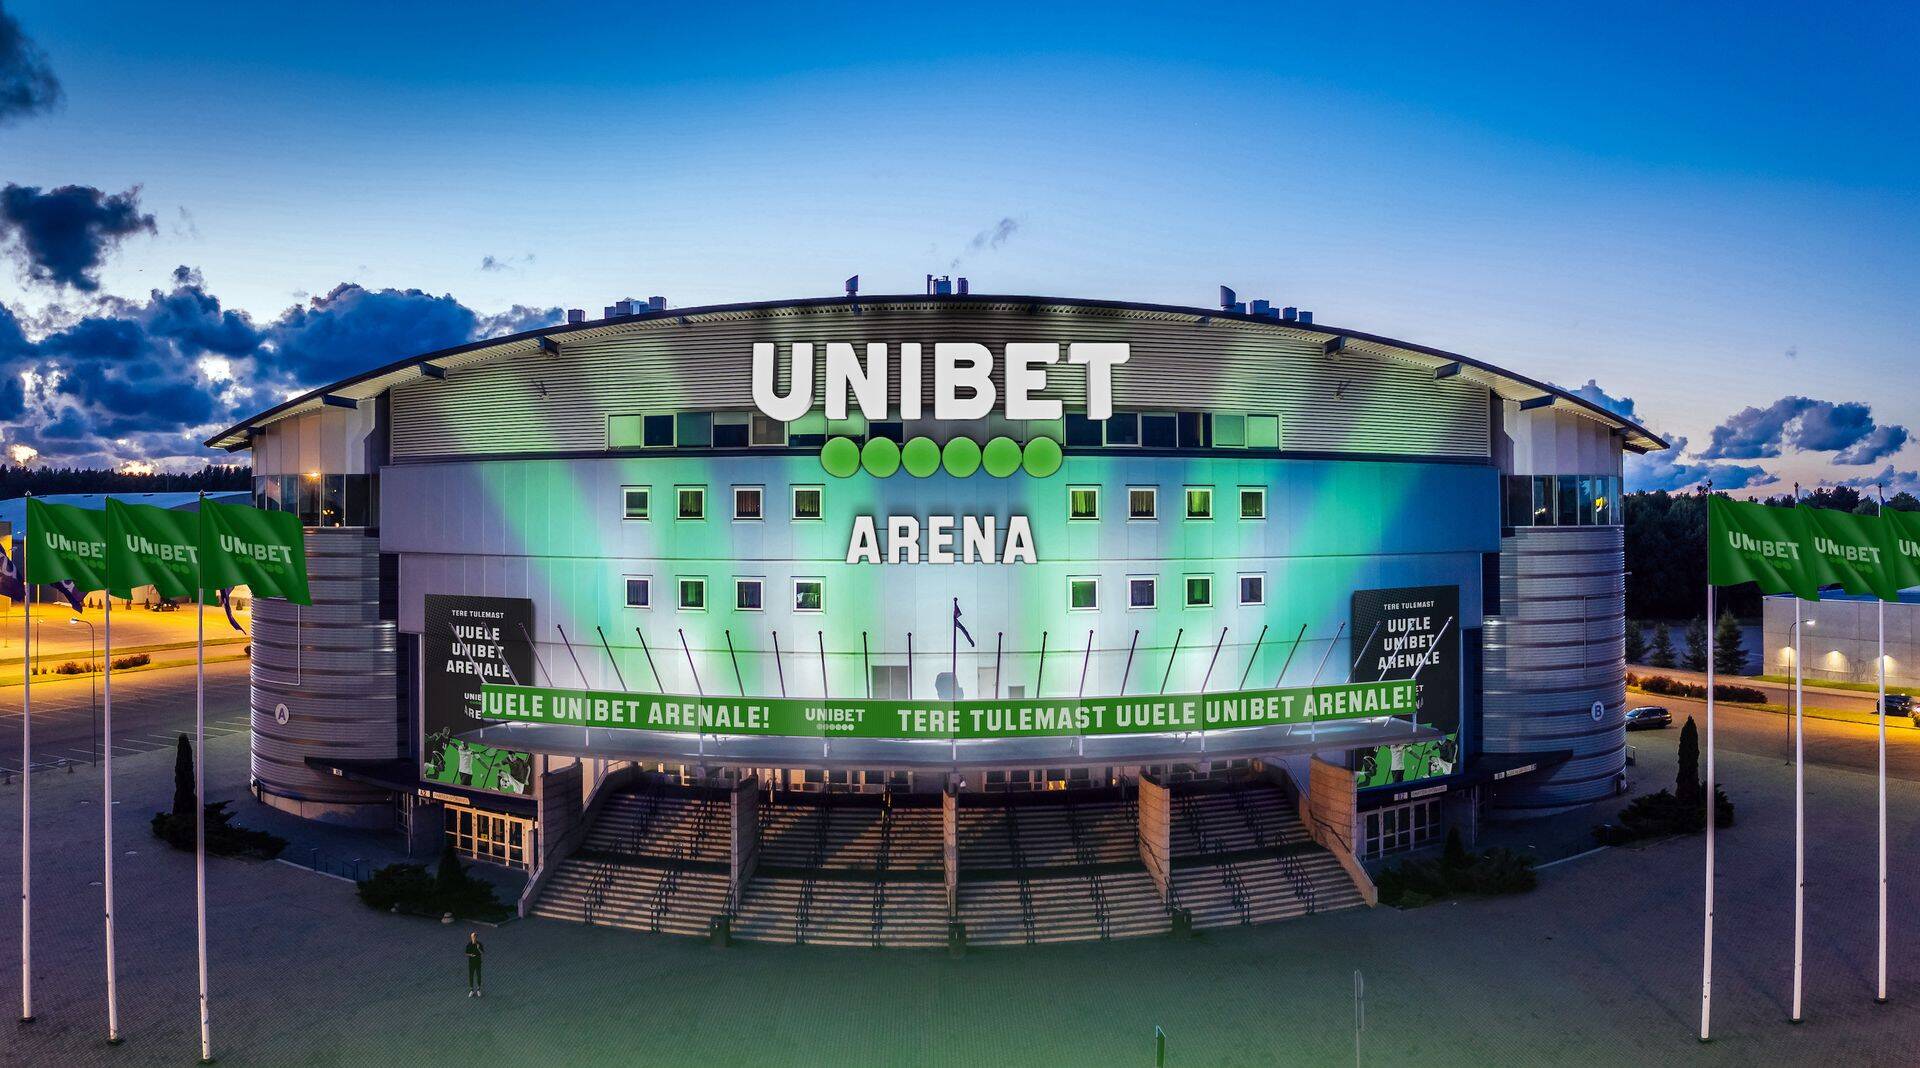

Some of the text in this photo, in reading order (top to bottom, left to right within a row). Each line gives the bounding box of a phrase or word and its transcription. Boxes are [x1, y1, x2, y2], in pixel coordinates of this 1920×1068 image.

[752, 342, 1131, 422] UNIBET
[126, 534, 198, 564] UNIBET
[220, 534, 292, 564] UNIBET
[845, 515, 1038, 564] ARENA
[1728, 531, 1800, 560] UNIBET
[1814, 537, 1881, 563] UNIBET
[452, 609, 504, 619] TERE TULEMAST
[1401, 600, 1435, 609] TULEMAST
[456, 625, 500, 640] UUELE
[1387, 616, 1431, 633] UUELE
[452, 642, 504, 659] UNIBET
[1383, 634, 1435, 651] UNIBET
[446, 659, 510, 678] ARENALE
[1377, 651, 1440, 670] ARENALE
[552, 696, 640, 723] UNIBET
[647, 702, 770, 729] ARENALE!
[805, 707, 865, 722] UNIBET
[897, 708, 960, 732] TERE
[970, 704, 1107, 731] TULEMAST
[1116, 701, 1196, 727] UUELE
[1206, 695, 1295, 722] UNIBET
[1303, 685, 1413, 717] ARENALE!
